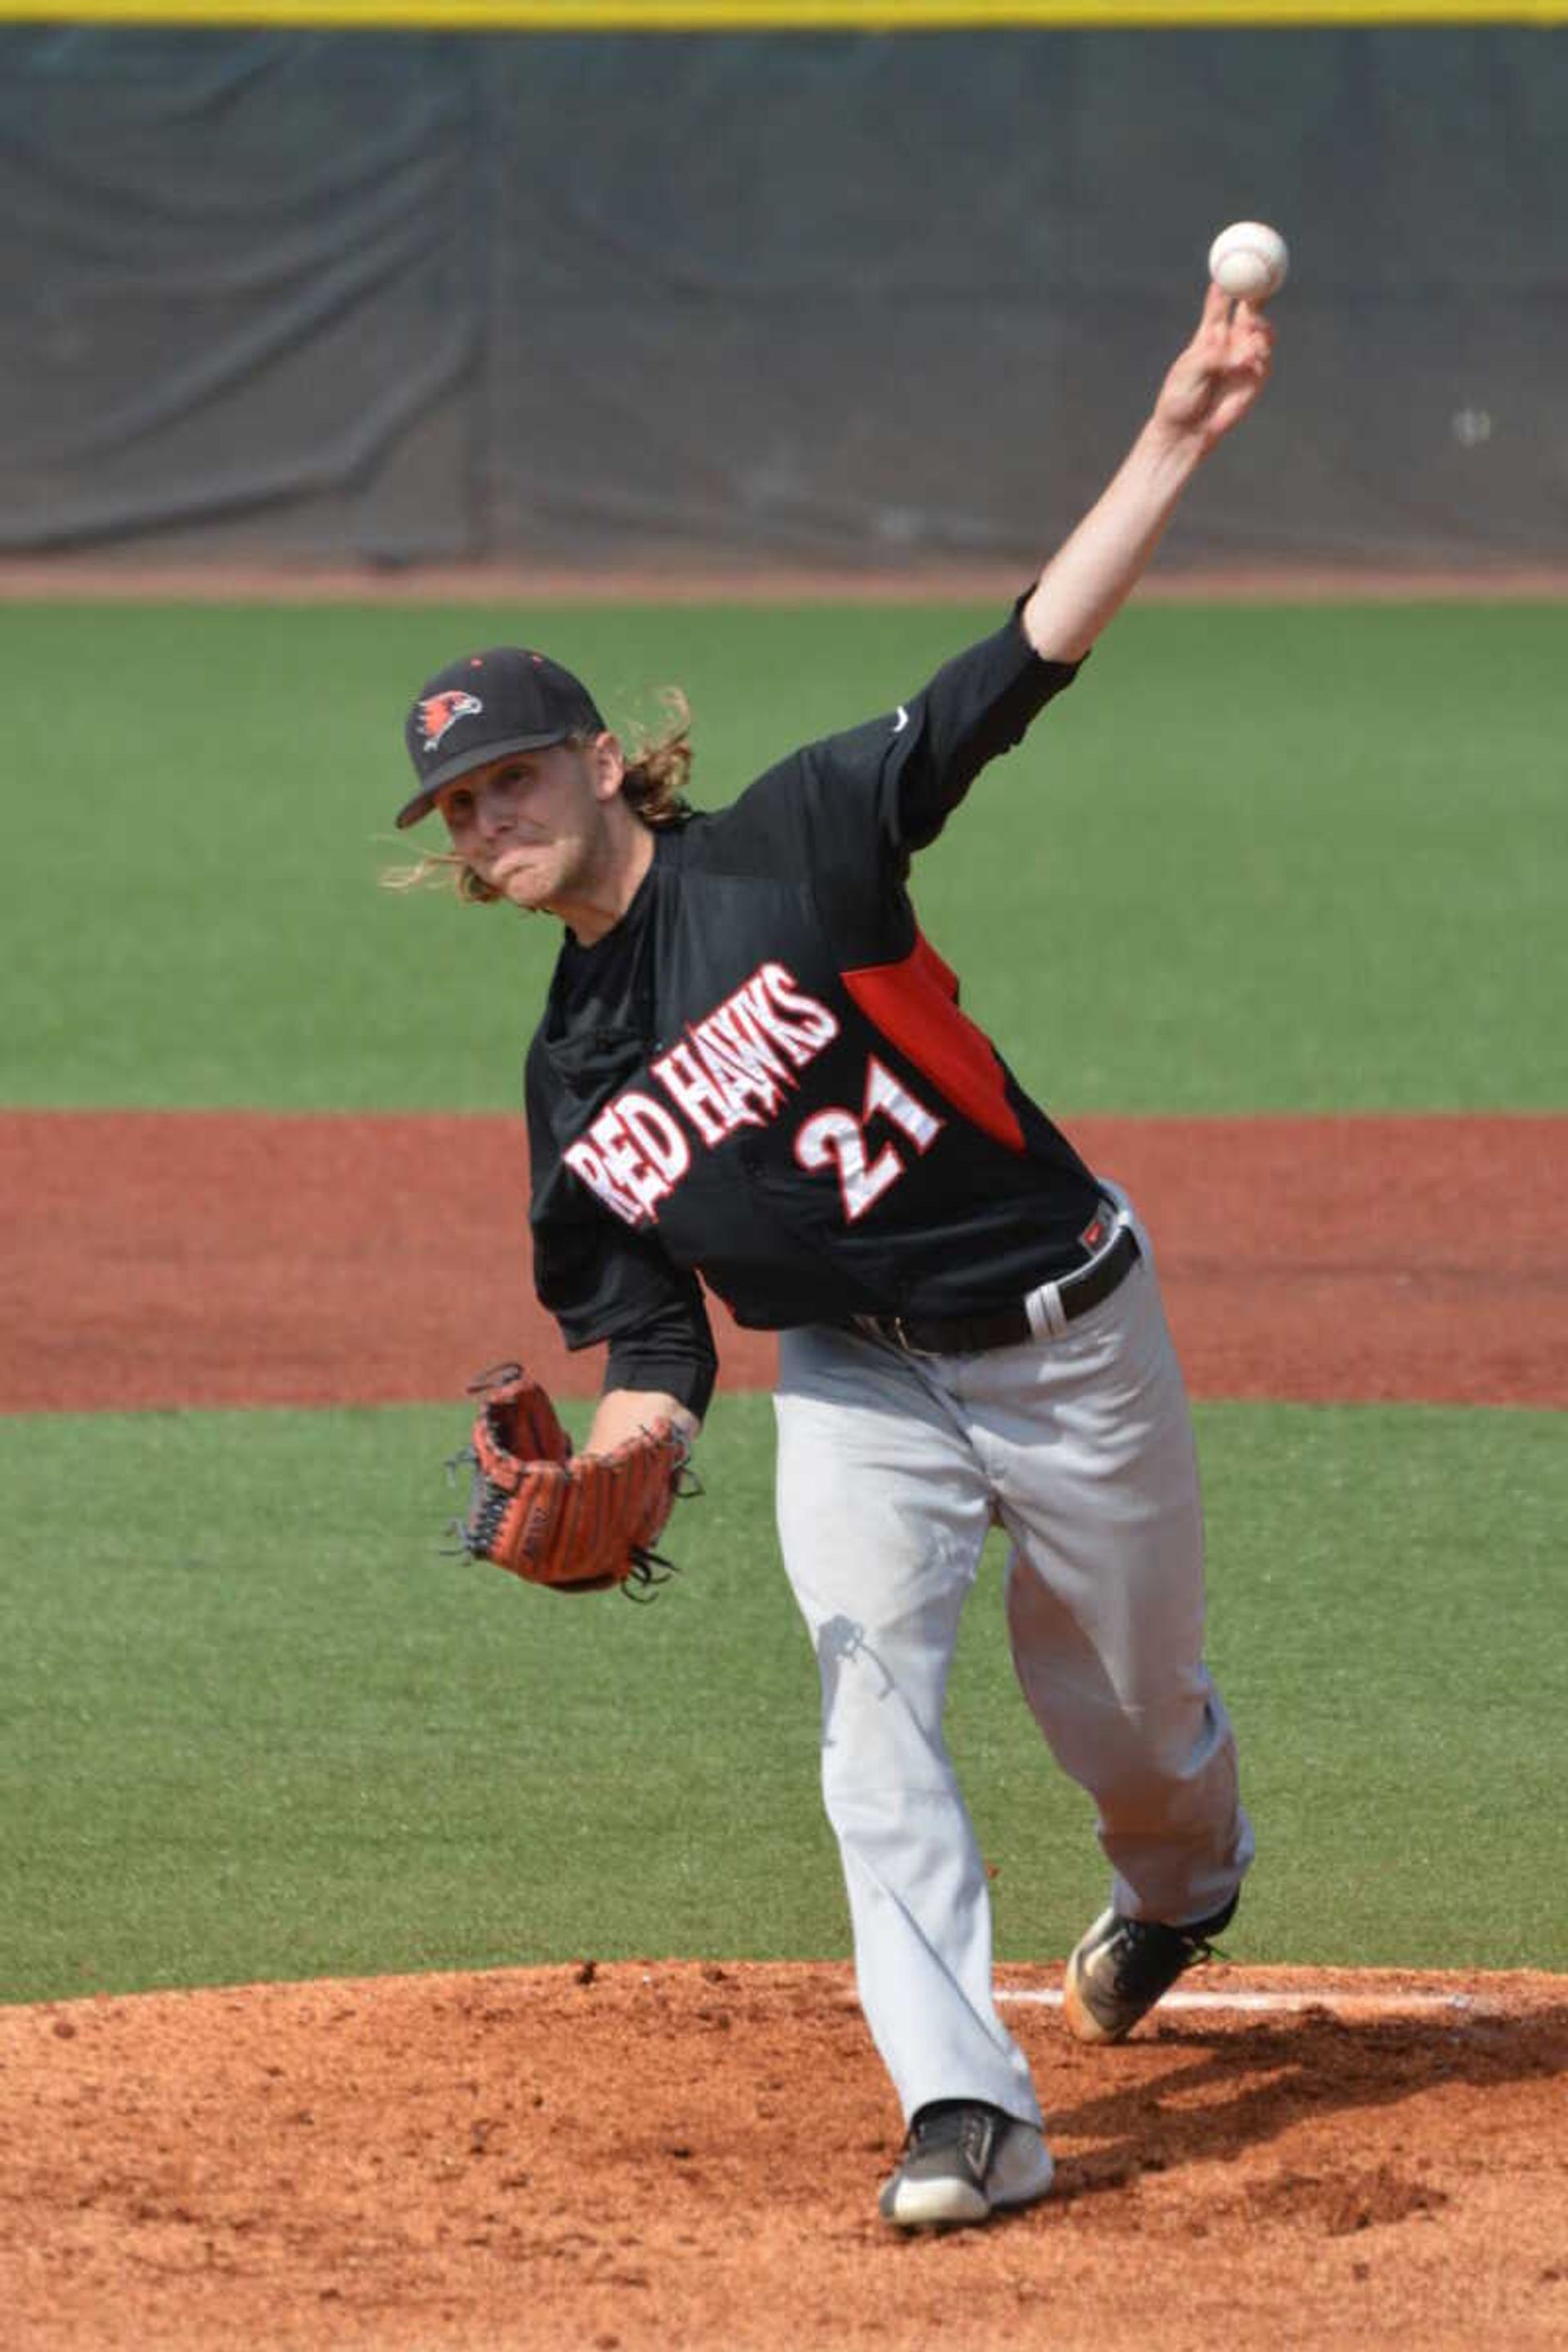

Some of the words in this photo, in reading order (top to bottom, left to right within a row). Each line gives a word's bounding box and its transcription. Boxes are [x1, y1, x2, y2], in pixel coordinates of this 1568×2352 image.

[564, 1091, 690, 1224] RED
[651, 961, 840, 1148] HAWKS
[795, 1055, 946, 1221] 21
